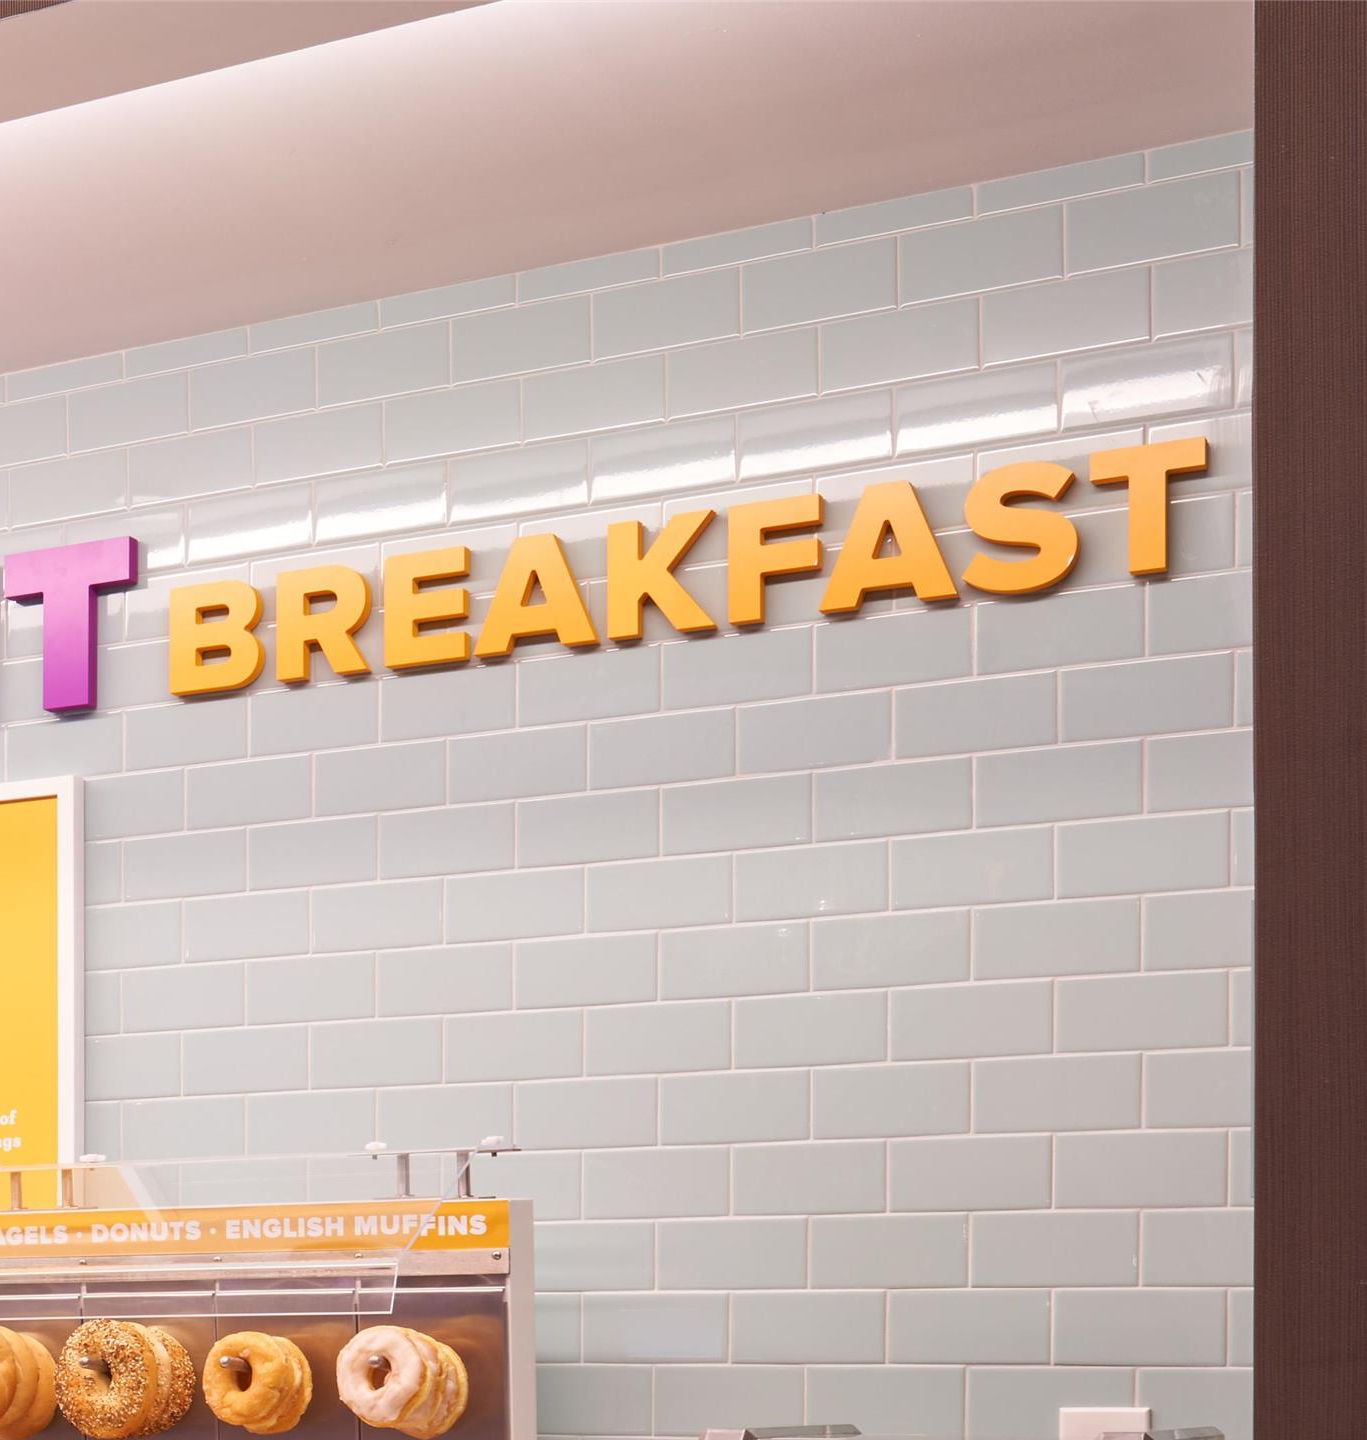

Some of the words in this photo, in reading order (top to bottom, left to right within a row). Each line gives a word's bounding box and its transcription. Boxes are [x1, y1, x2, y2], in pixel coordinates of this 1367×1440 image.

[167, 434, 1209, 698] BREAKFAST
[0, 1109, 17, 1126] of
[91, 1220, 201, 1244] DONUTS
[225, 1216, 345, 1240] ENGLISH
[353, 1213, 489, 1238] MUFFINS
